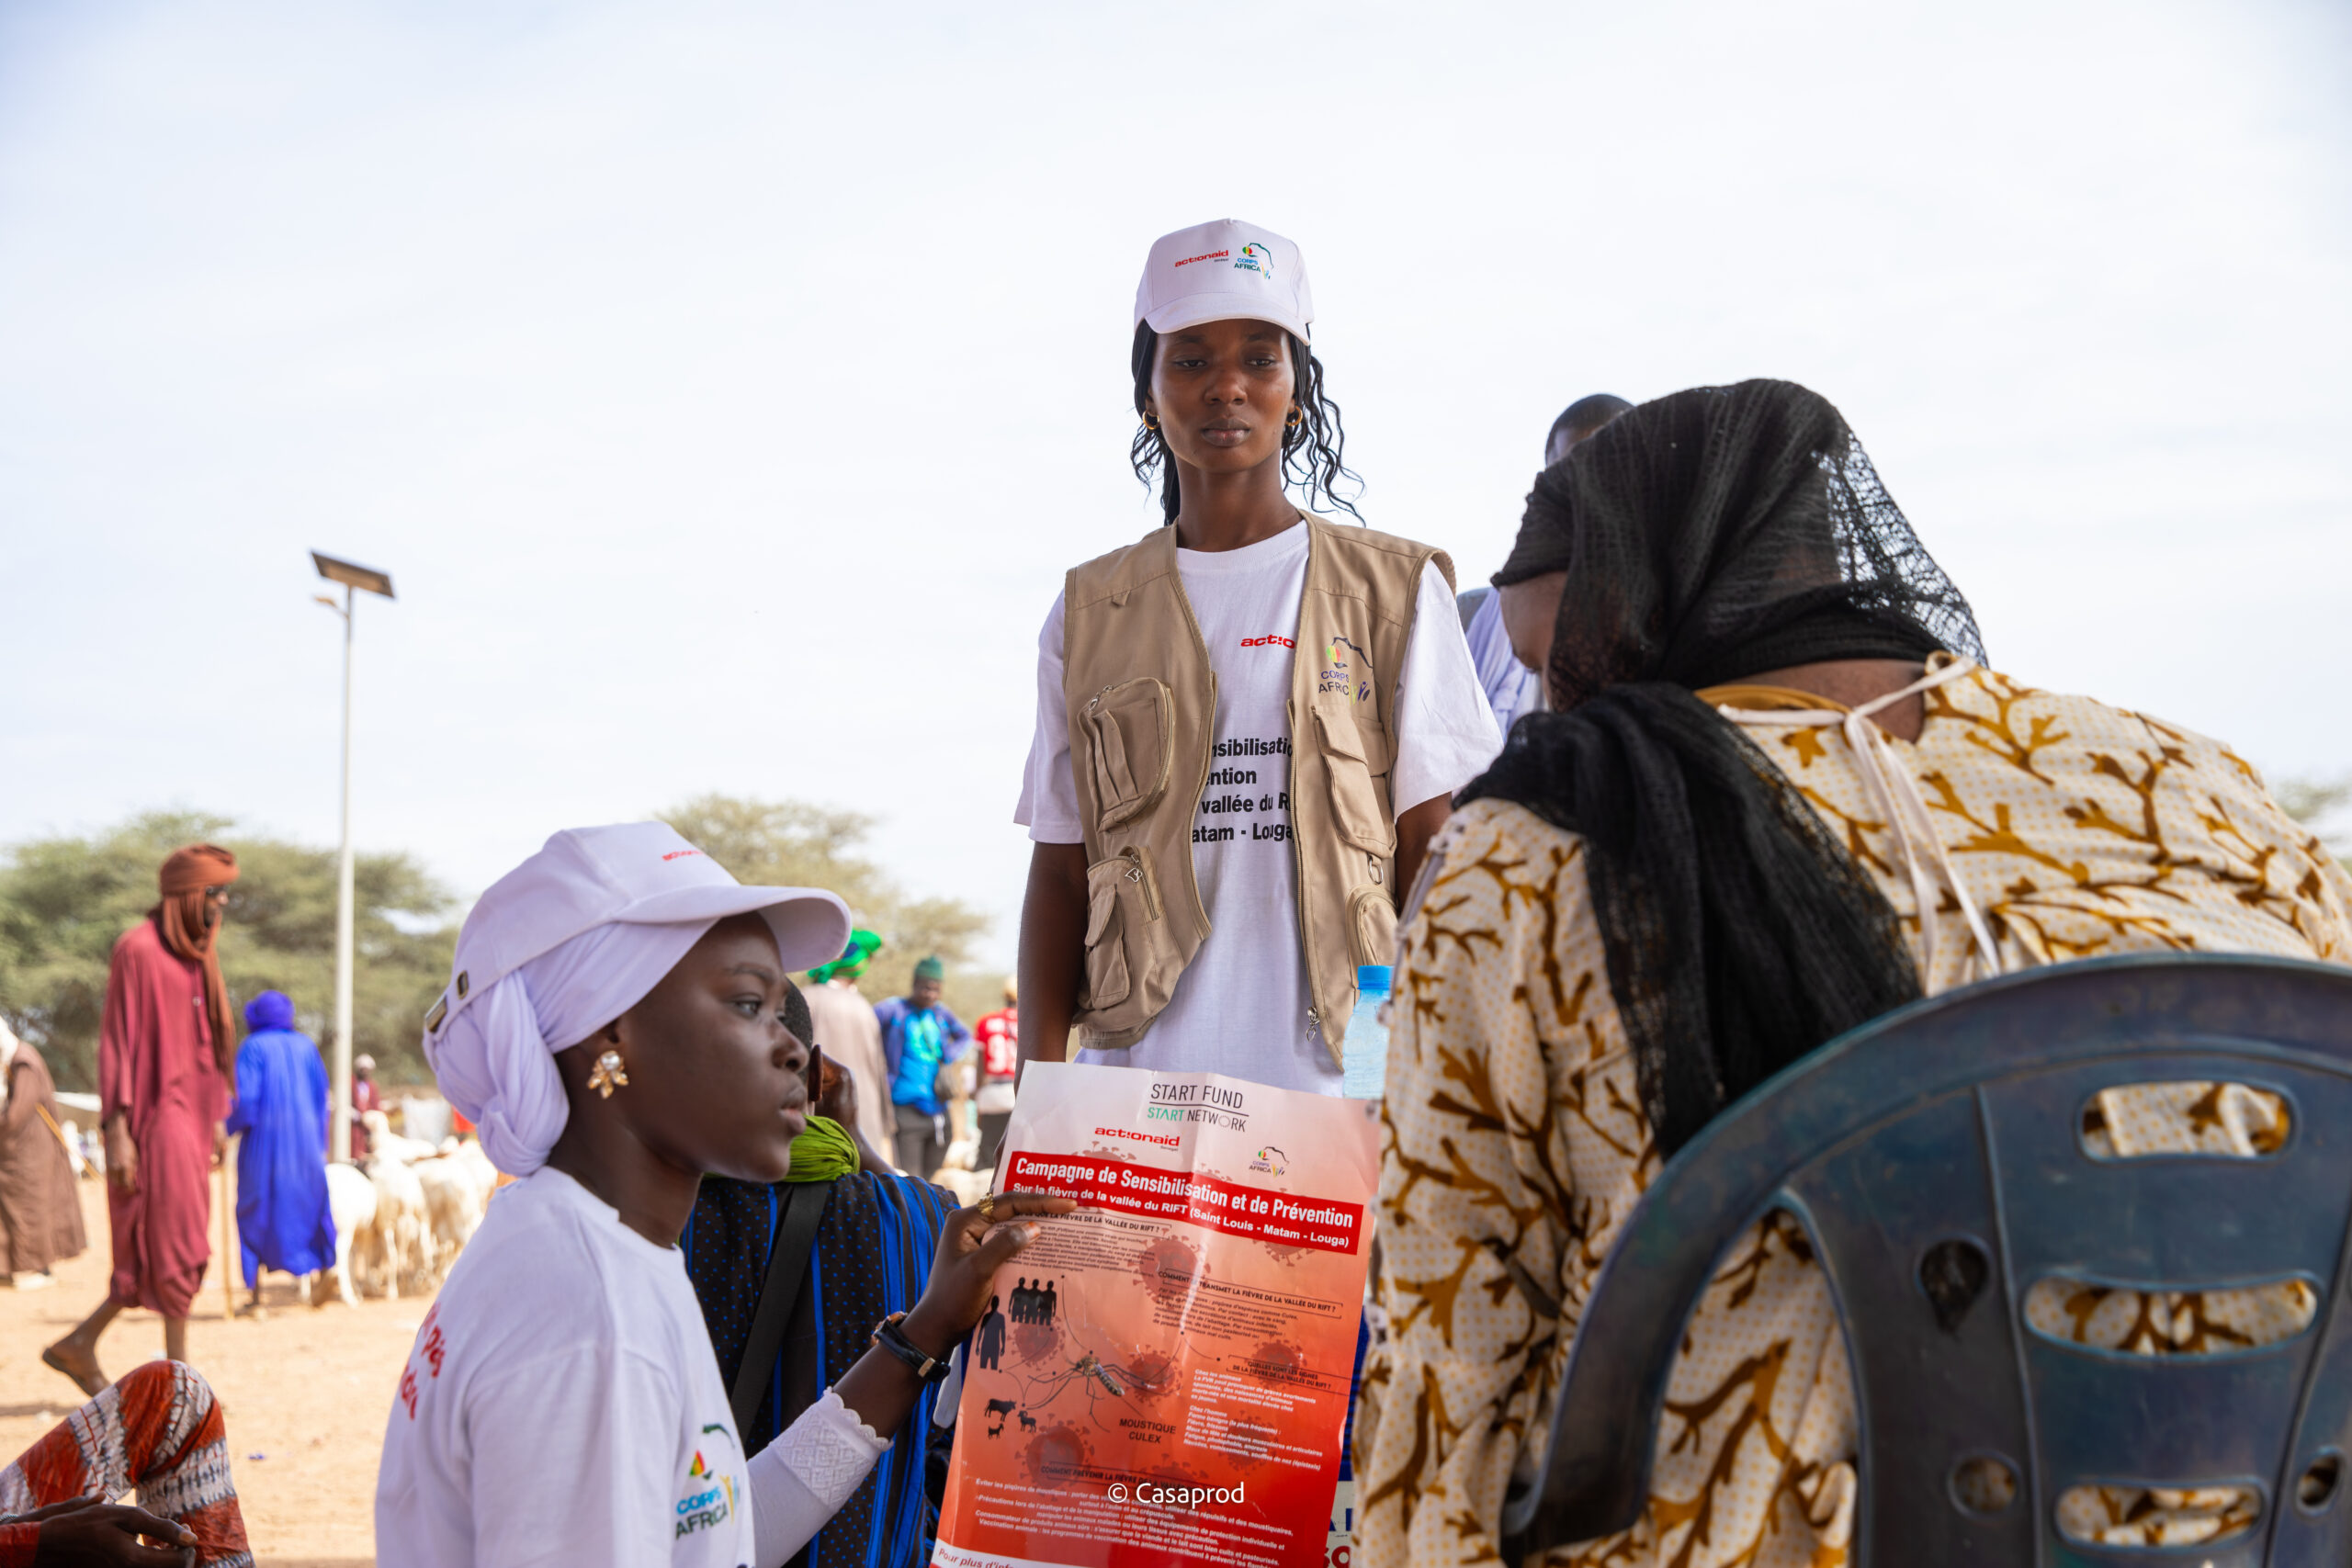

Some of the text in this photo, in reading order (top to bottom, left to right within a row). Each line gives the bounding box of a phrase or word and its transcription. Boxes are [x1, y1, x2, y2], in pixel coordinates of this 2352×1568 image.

[1234, 263, 1261, 272] AFRICA
[1321, 670, 1349, 682] CORPS
[1201, 795, 1253, 814] vallée
[1260, 794, 1273, 810] du
[1150, 1083, 1243, 1109] START FUND
[1147, 1107, 1247, 1133] START NETWORK
[1249, 1165, 1272, 1173] AFRICA
[1016, 1157, 1352, 1227] Campagne de Sensibilisation et de Prévention
[1012, 1183, 1033, 1194] Sur
[1035, 1185, 1045, 1195] la
[1047, 1186, 1078, 1199] fièvre
[1080, 1189, 1094, 1200] de
[1096, 1190, 1107, 1201] la
[1109, 1194, 1141, 1208] vallée
[1144, 1201, 1159, 1211] du
[1161, 1202, 1188, 1214] RIFT
[1190, 1207, 1220, 1224] (Saint
[1223, 1216, 1254, 1231] Louis
[1263, 1224, 1300, 1240] Matam
[1310, 1232, 1350, 1248] Louga)
[1083, 1214, 1092, 1223] DE
[1093, 1215, 1102, 1224] LA
[1104, 1218, 1127, 1228] VALLÉE
[1140, 1224, 1155, 1232] RIFT
[1199, 1280, 1231, 1293] TRANSMET
[1264, 1293, 1273, 1302] DE
[1273, 1294, 1283, 1303] LA
[1119, 1418, 1177, 1434] MOUSTIQUE
[1128, 1431, 1161, 1444] CULEX
[938, 1548, 958, 1563] Pour
